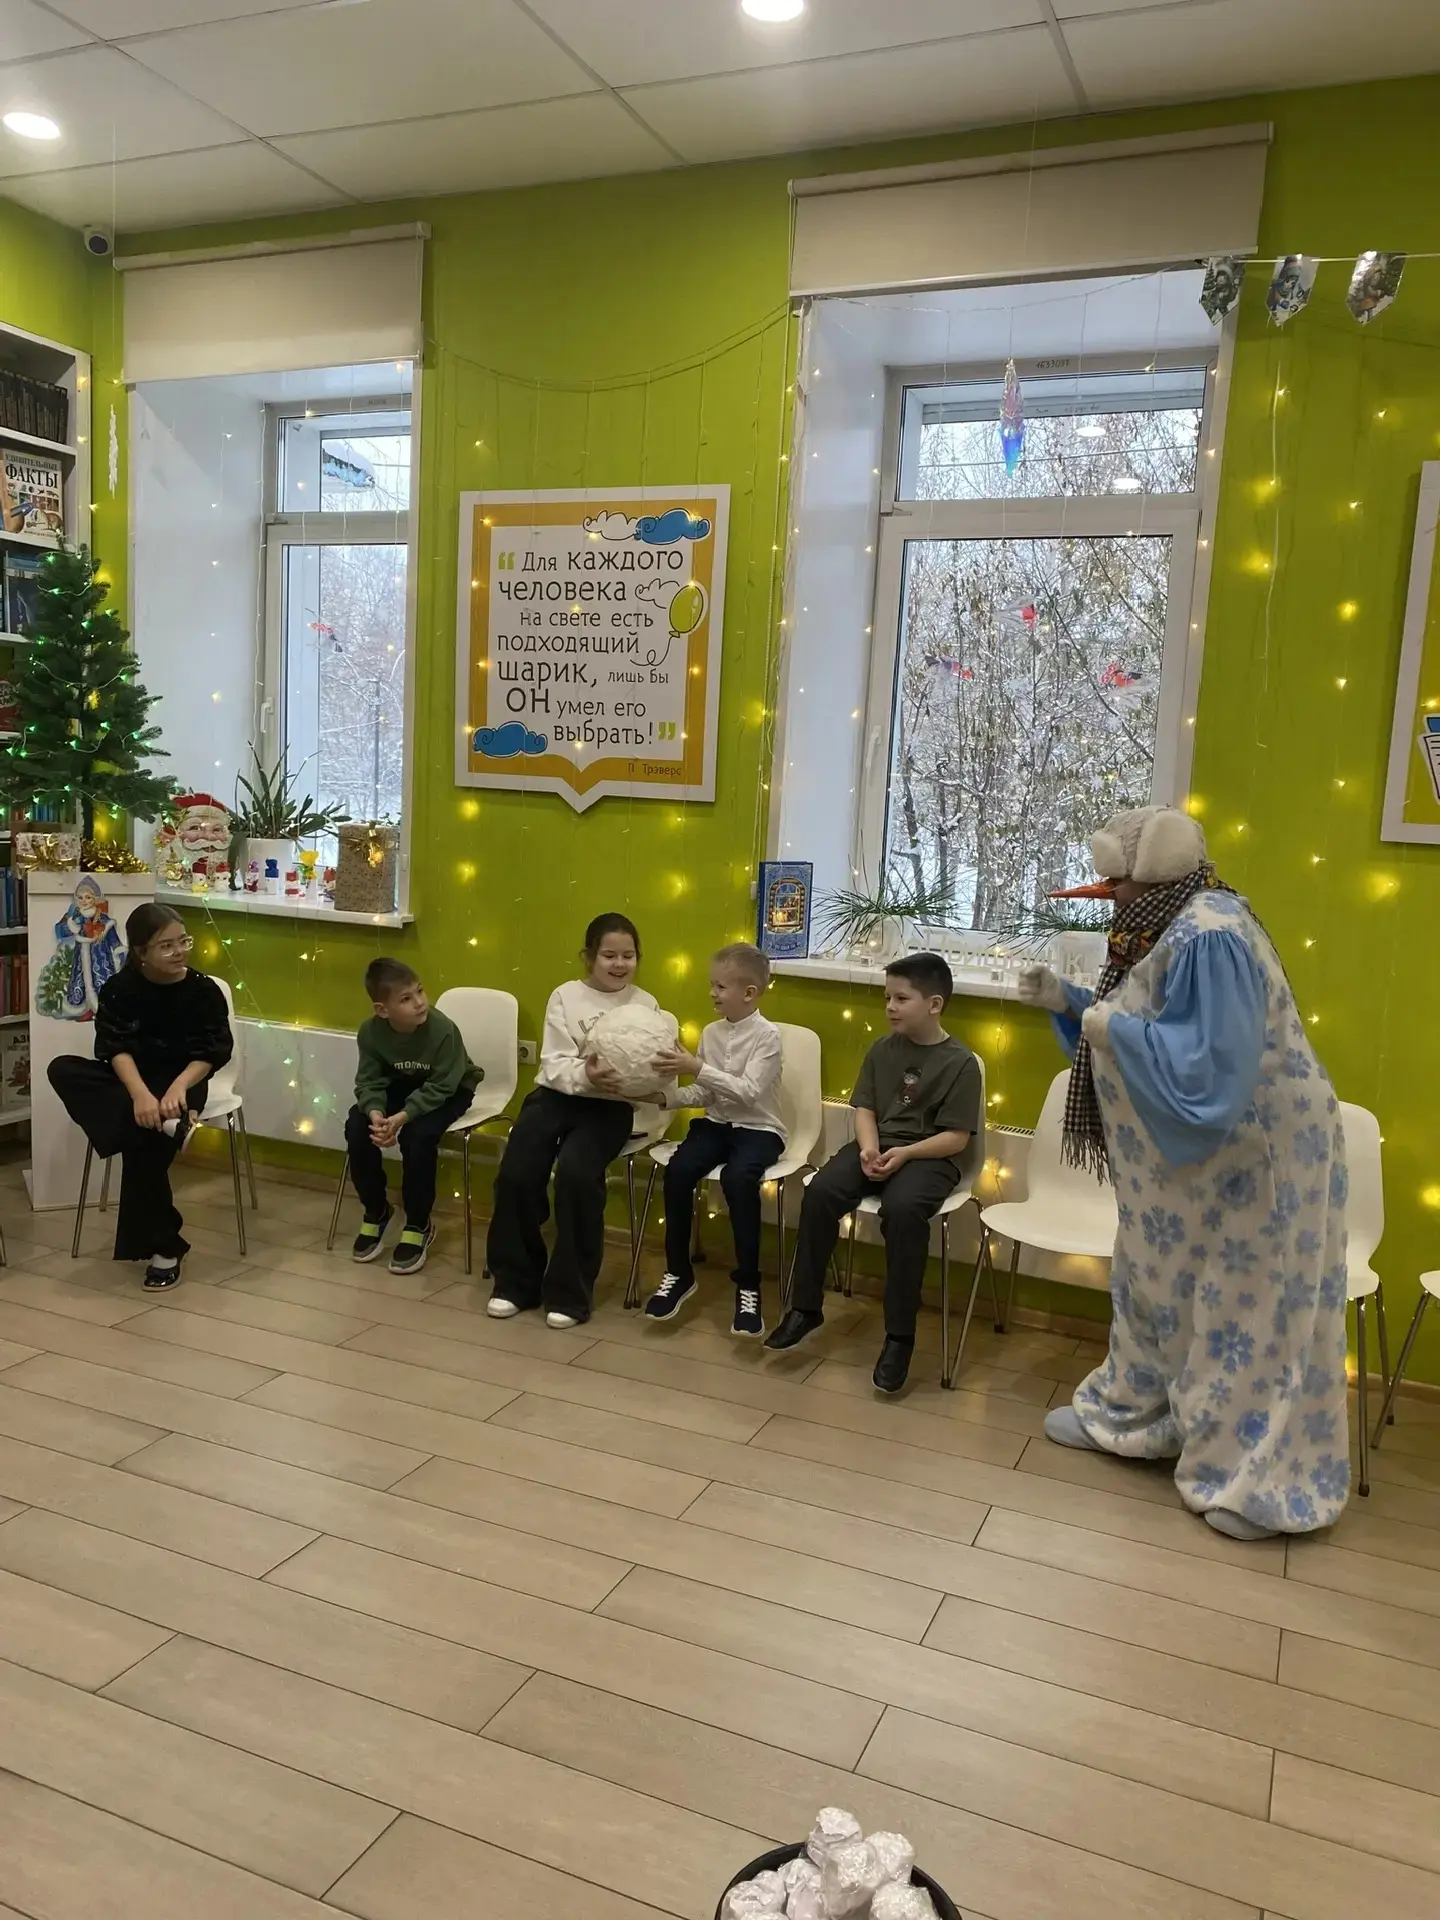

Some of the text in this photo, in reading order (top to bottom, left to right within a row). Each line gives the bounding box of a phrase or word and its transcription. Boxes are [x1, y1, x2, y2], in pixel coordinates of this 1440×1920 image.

[5, 463, 58, 489] ФАКТЫ
[521, 550, 684, 572] Для каждого
[498, 580, 627, 601] человека
[520, 612, 654, 627] на свете есть
[497, 631, 640, 654] подходящий
[497, 660, 669, 690] шарик, лишь бы
[556, 700, 605, 719] умел
[614, 702, 646, 717] его
[553, 719, 654, 749] выбрать!
[642, 763, 681, 776] Трэверс
